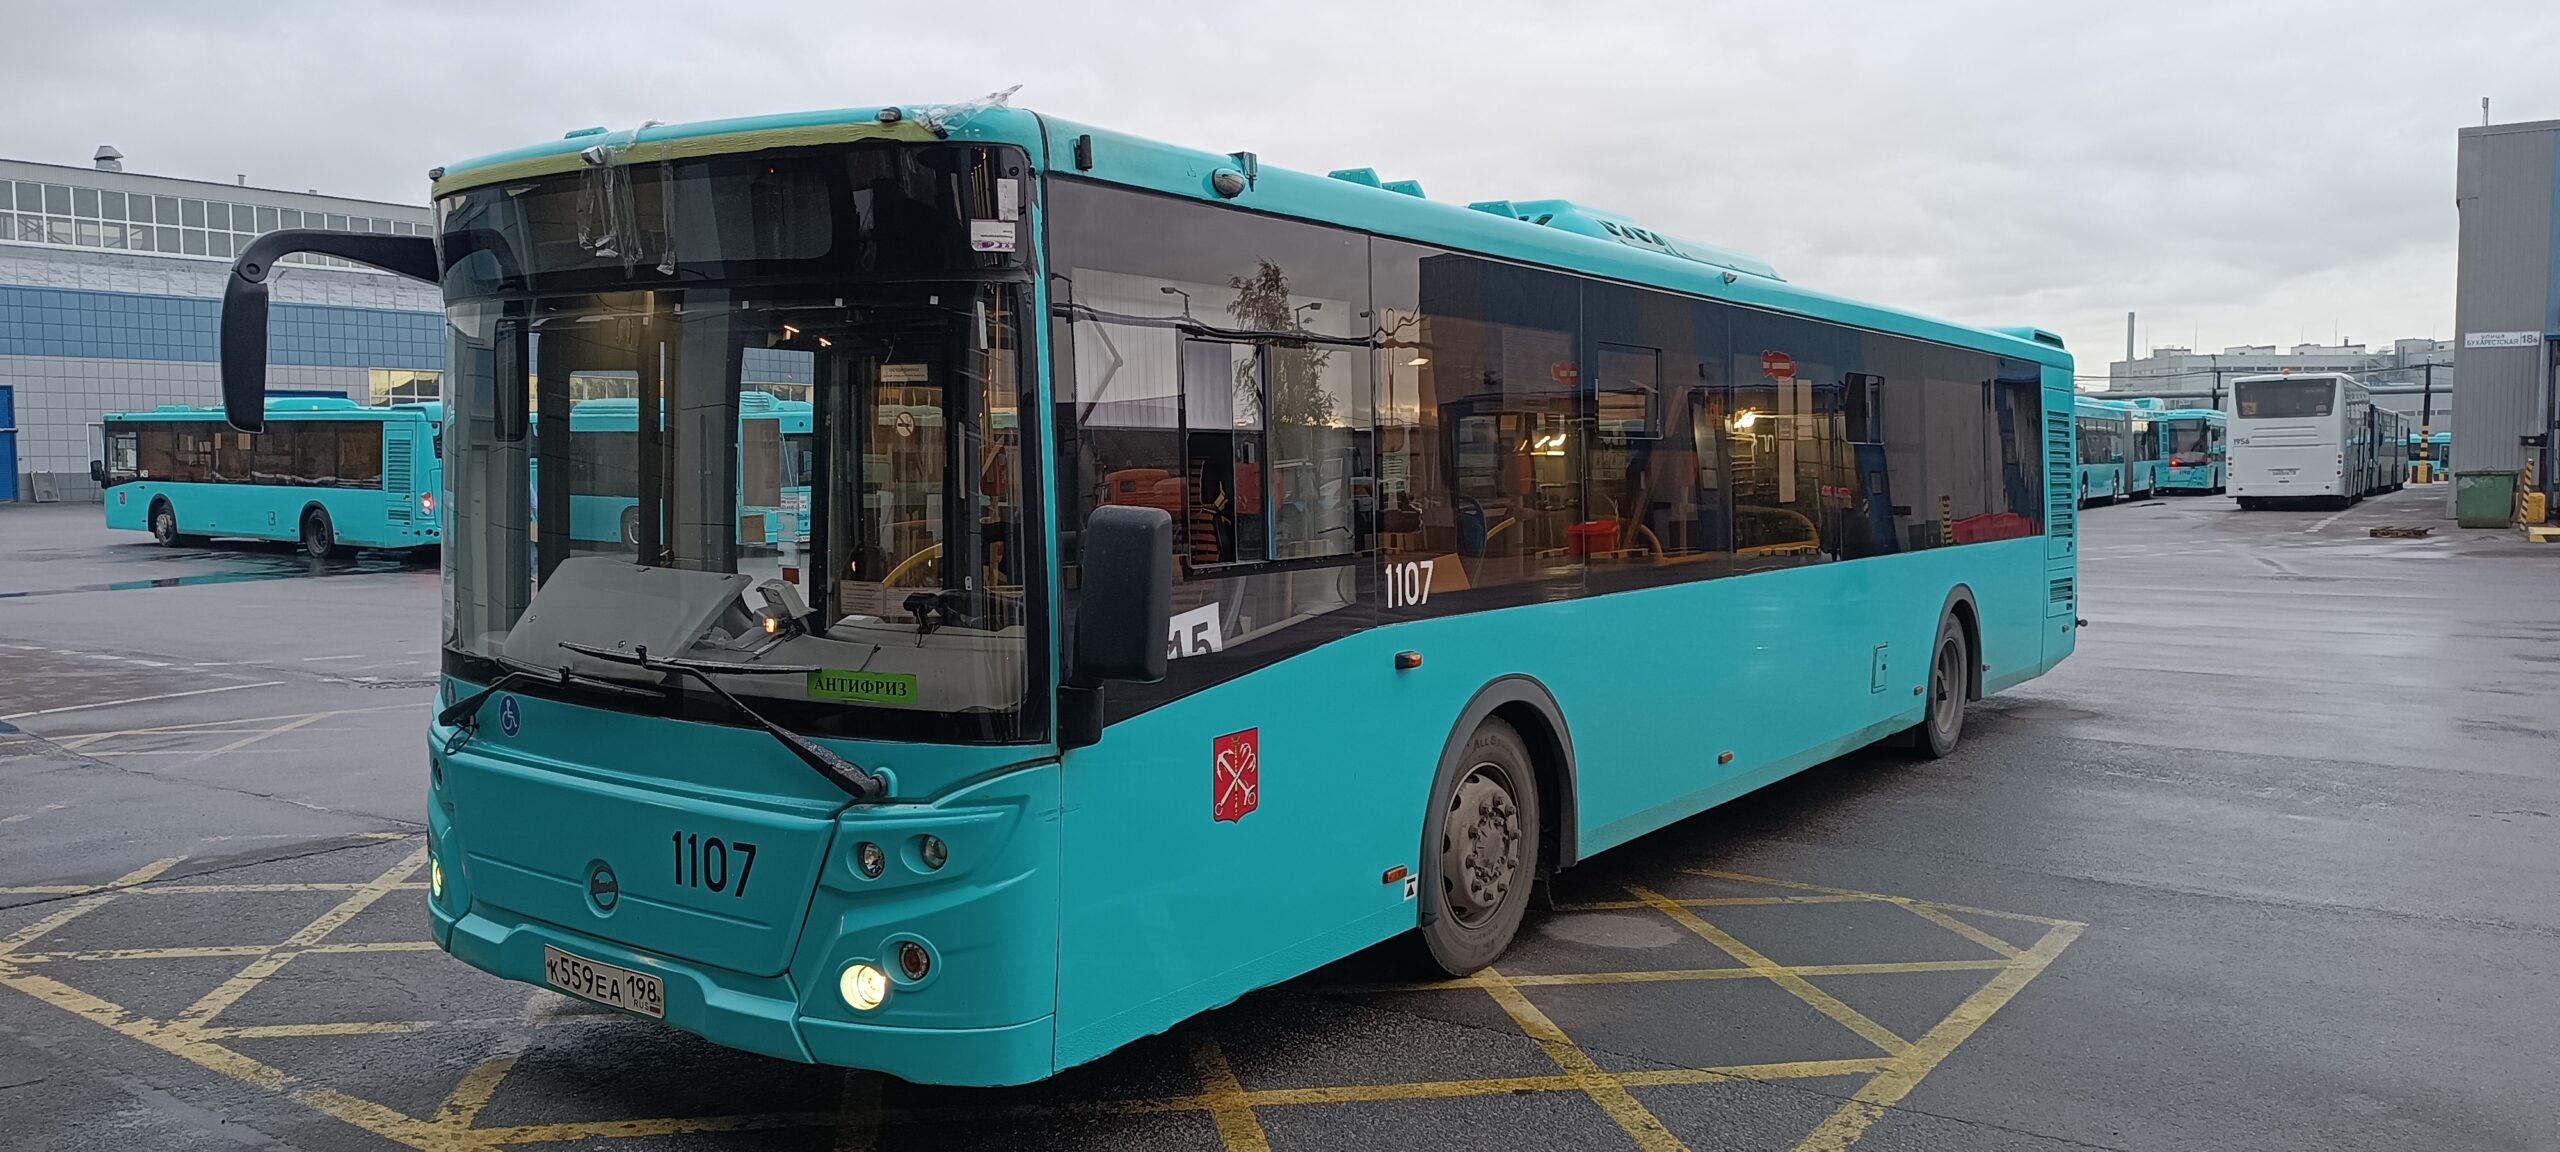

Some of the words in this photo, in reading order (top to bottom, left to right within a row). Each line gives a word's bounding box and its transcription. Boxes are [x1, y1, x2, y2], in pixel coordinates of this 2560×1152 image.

[1385, 560, 1434, 609] 1107
[814, 676, 907, 697] АНТИФРИЗ
[671, 830, 758, 898] 1107
[626, 975, 657, 1003] 198
[633, 998, 650, 1011] RUS
